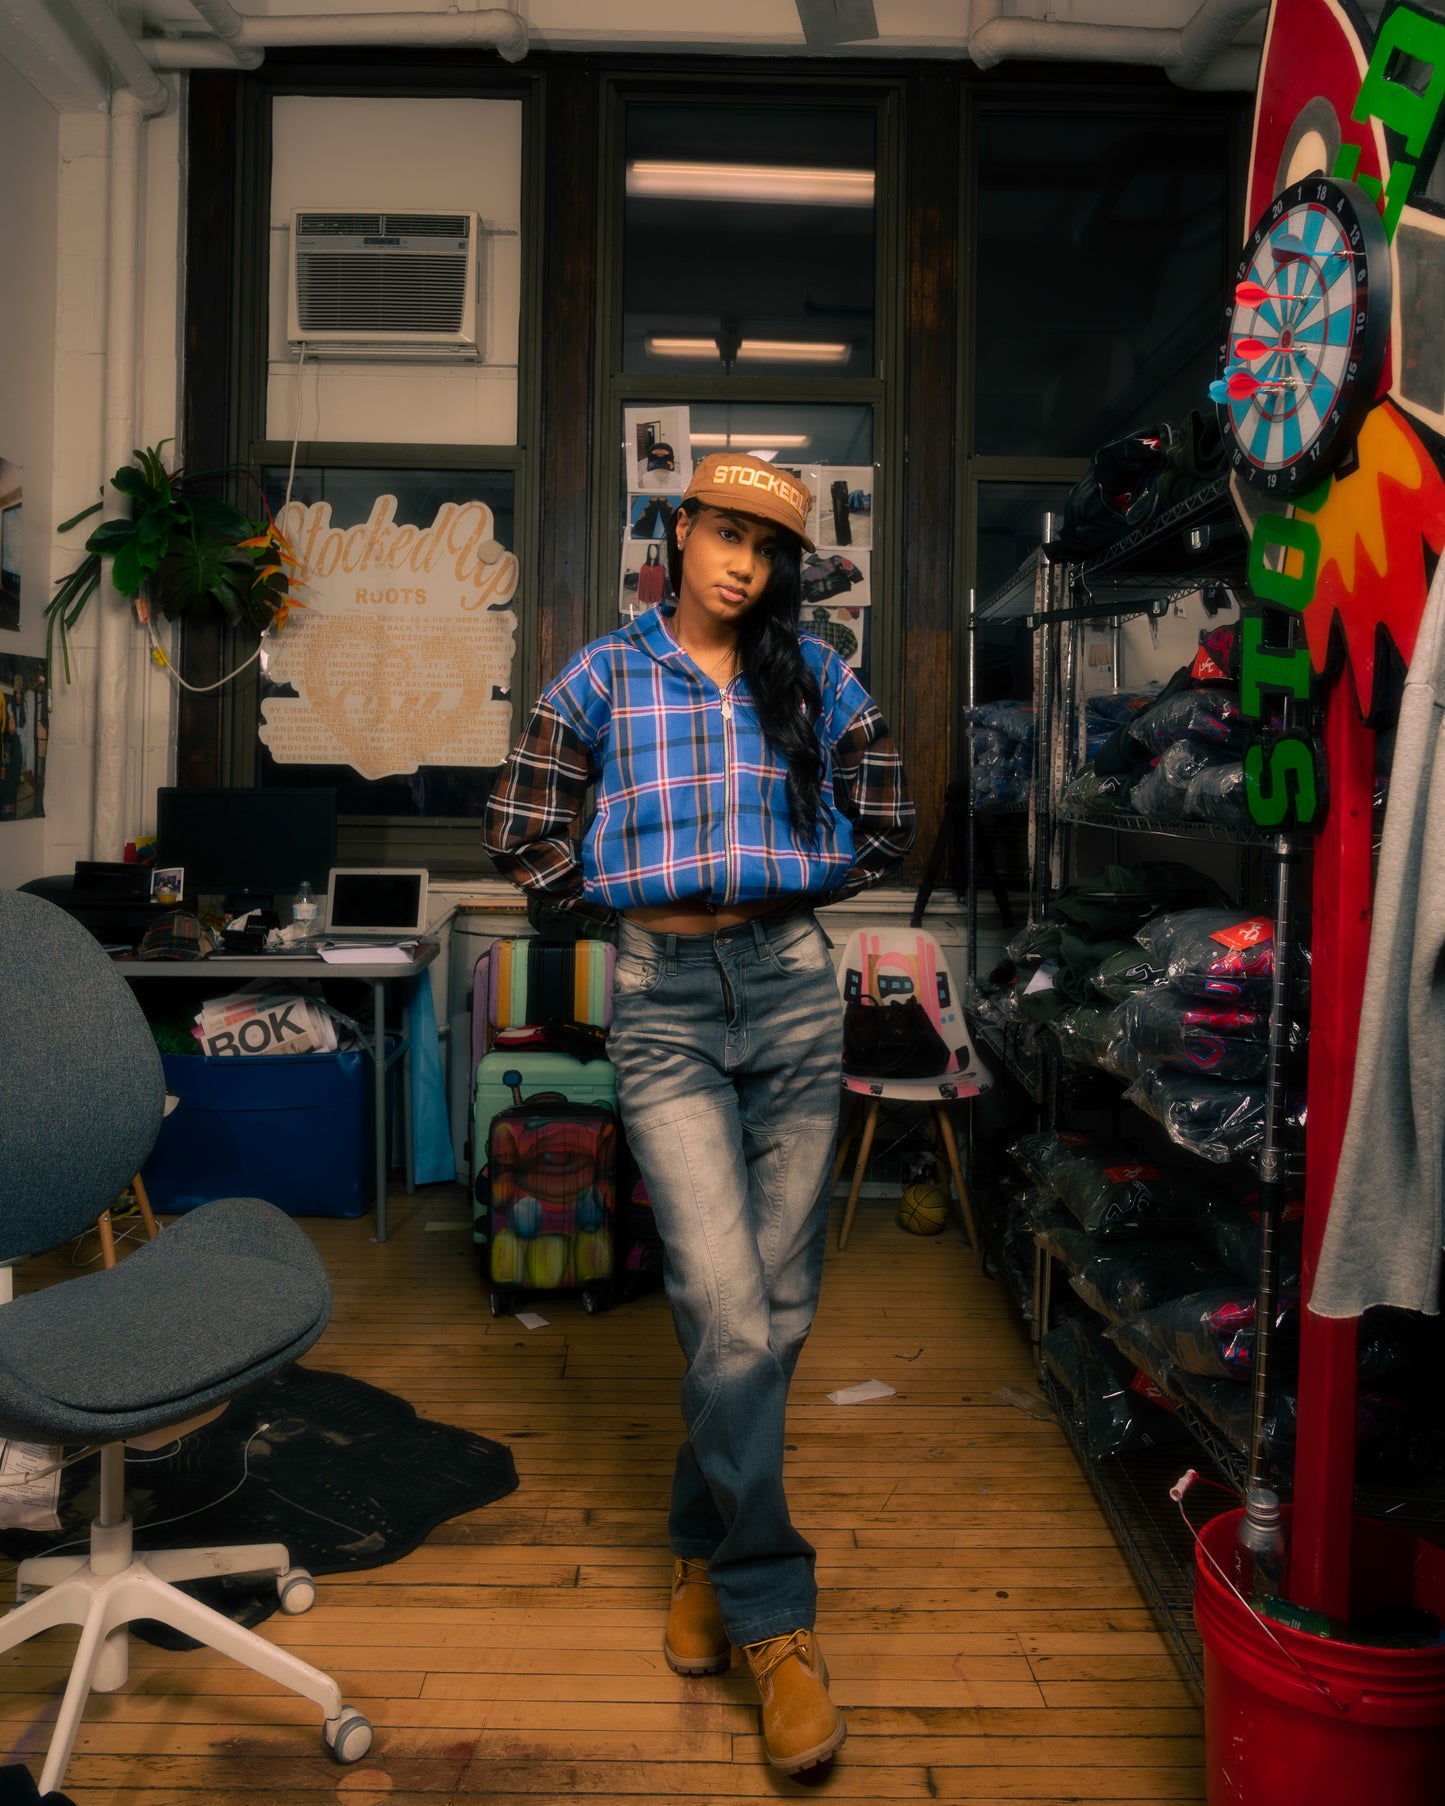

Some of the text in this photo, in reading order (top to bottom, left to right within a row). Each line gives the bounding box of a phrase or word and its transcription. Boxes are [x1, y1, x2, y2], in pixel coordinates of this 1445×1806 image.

[1316, 184, 1327, 200] 18
[1272, 201, 1283, 215] 20
[1337, 198, 1345, 213] 4
[1254, 230, 1261, 243] 5
[1350, 224, 1360, 244] 13
[1355, 311, 1365, 331] 10
[1219, 343, 1227, 361] 14
[1346, 363, 1357, 382] 15
[1332, 409, 1340, 424] 2
[1232, 449, 1242, 465] 16
[1309, 442, 1321, 460] 17
[1249, 468, 1256, 481] 7
[1266, 474, 1277, 488] 19
[1290, 467, 1297, 481] 3
[284, 498, 518, 612] Stocked Up
[354, 586, 428, 605] ROOTS
[496, 616, 510, 624] THE
[269, 641, 300, 649] THOSE
[326, 642, 346, 650] MAY
[291, 670, 327, 678] CREATE
[426, 671, 443, 679] ALL
[273, 725, 293, 733] AND
[466, 737, 485, 745] YOU
[303, 744, 328, 752] DOES
[444, 746, 463, 754] CAN
[484, 747, 504, 755] AND
[207, 1003, 306, 1056] BOK
